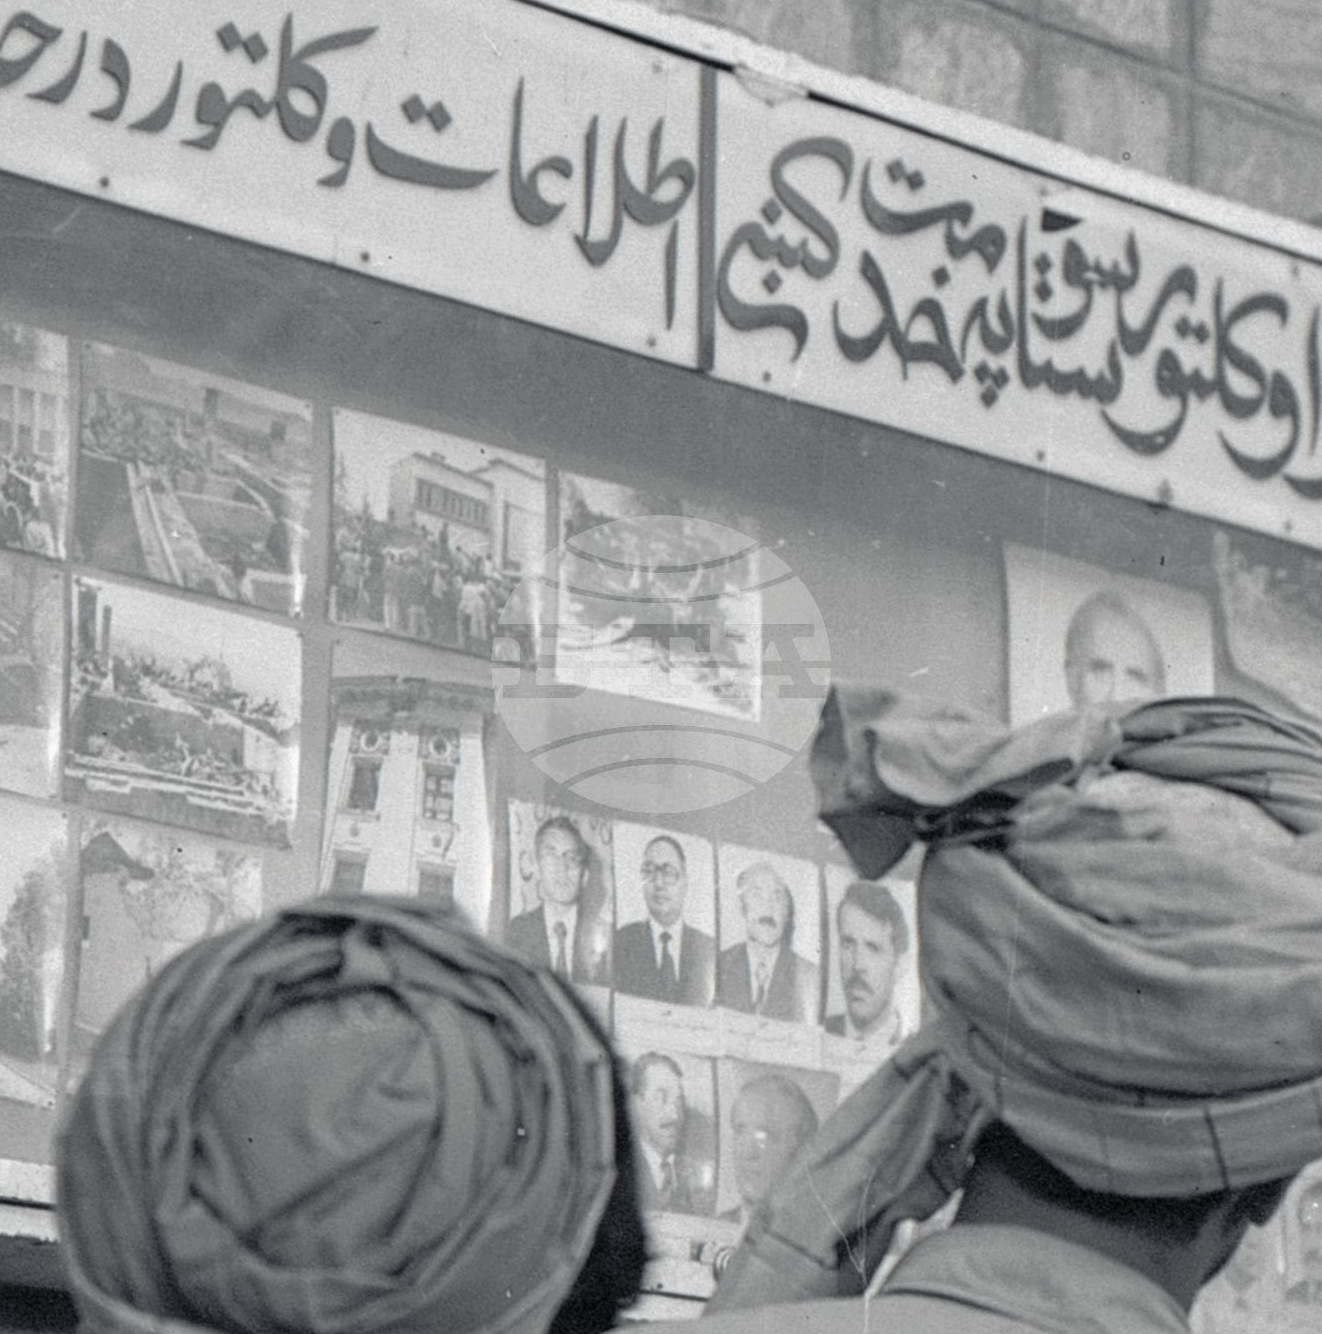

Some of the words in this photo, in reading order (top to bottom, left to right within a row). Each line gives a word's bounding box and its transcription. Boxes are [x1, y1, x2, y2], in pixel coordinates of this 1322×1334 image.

[24, 30, 131, 123] در
[317, 116, 356, 189] و
[367, 76, 695, 331] اطلاعات
[834, 158, 1008, 384] خدمت
